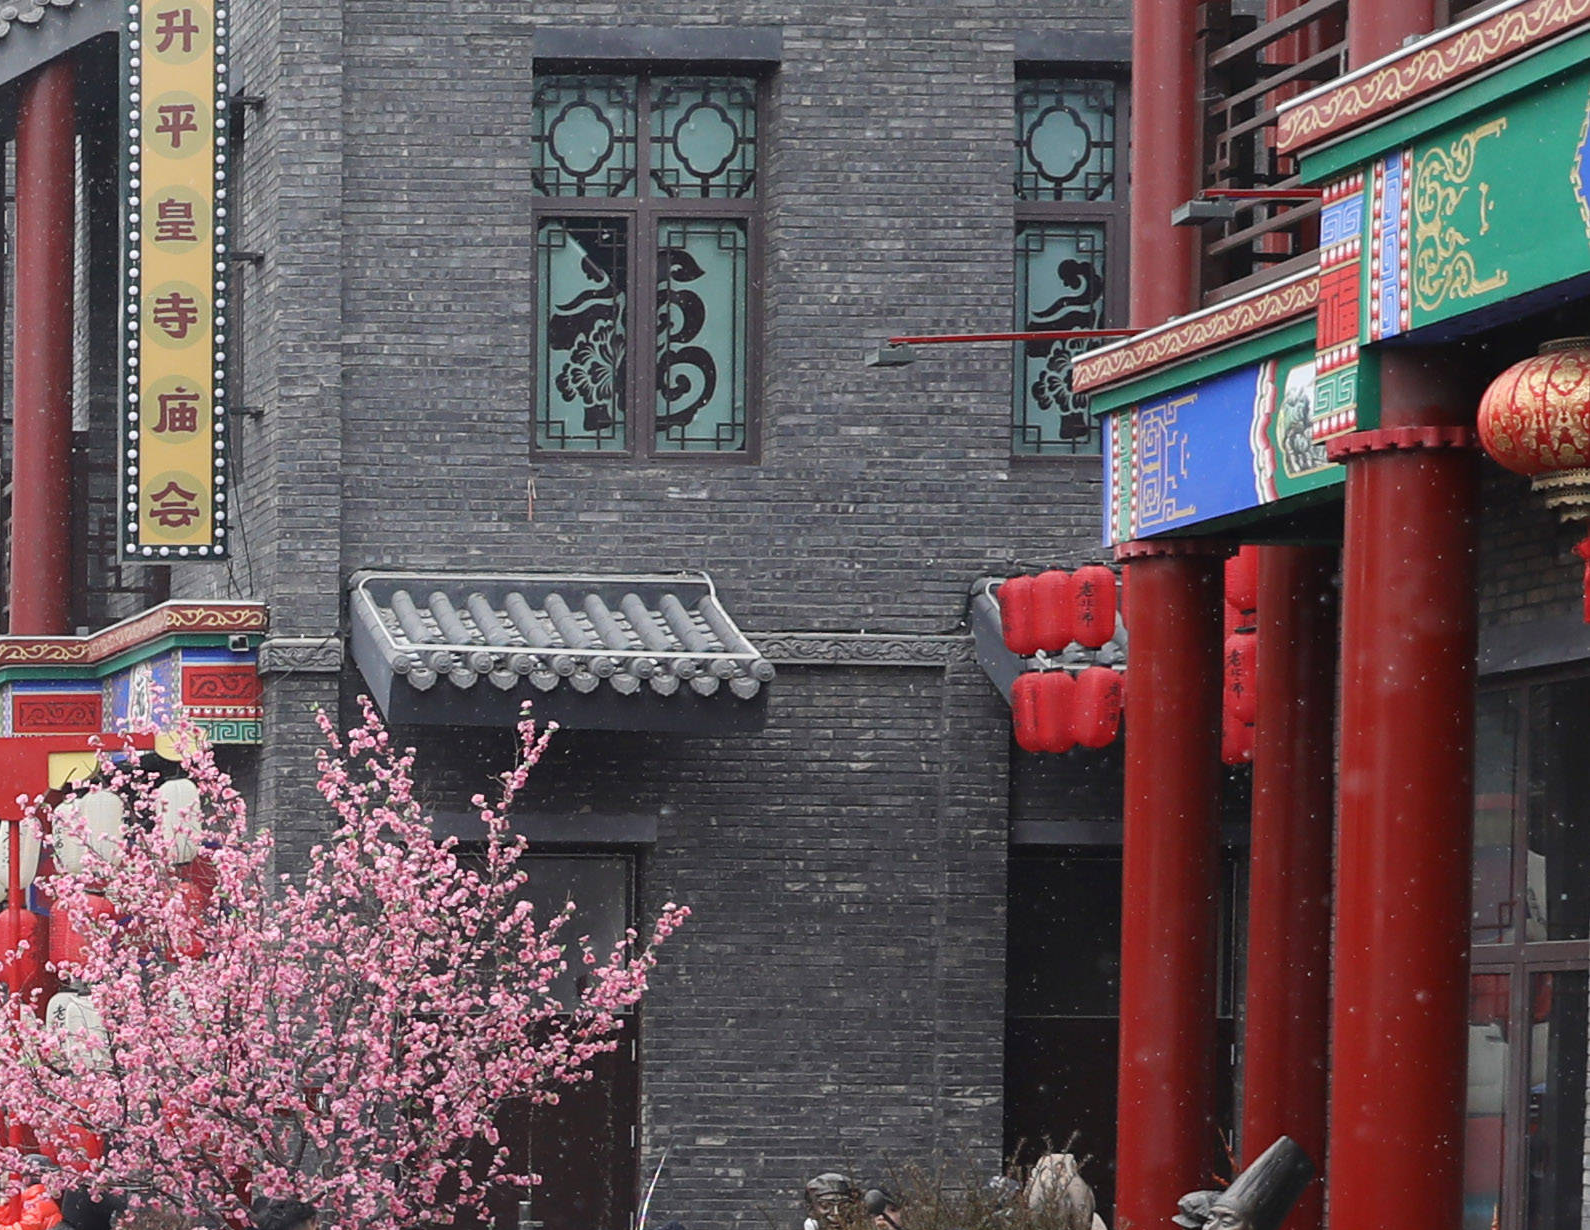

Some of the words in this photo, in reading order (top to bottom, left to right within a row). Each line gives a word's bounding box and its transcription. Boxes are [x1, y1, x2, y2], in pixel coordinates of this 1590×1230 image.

[149, 8, 201, 530] 升平皇寺庙会
[1076, 580, 1095, 629] 老北市
[1226, 648, 1246, 700] 老北市
